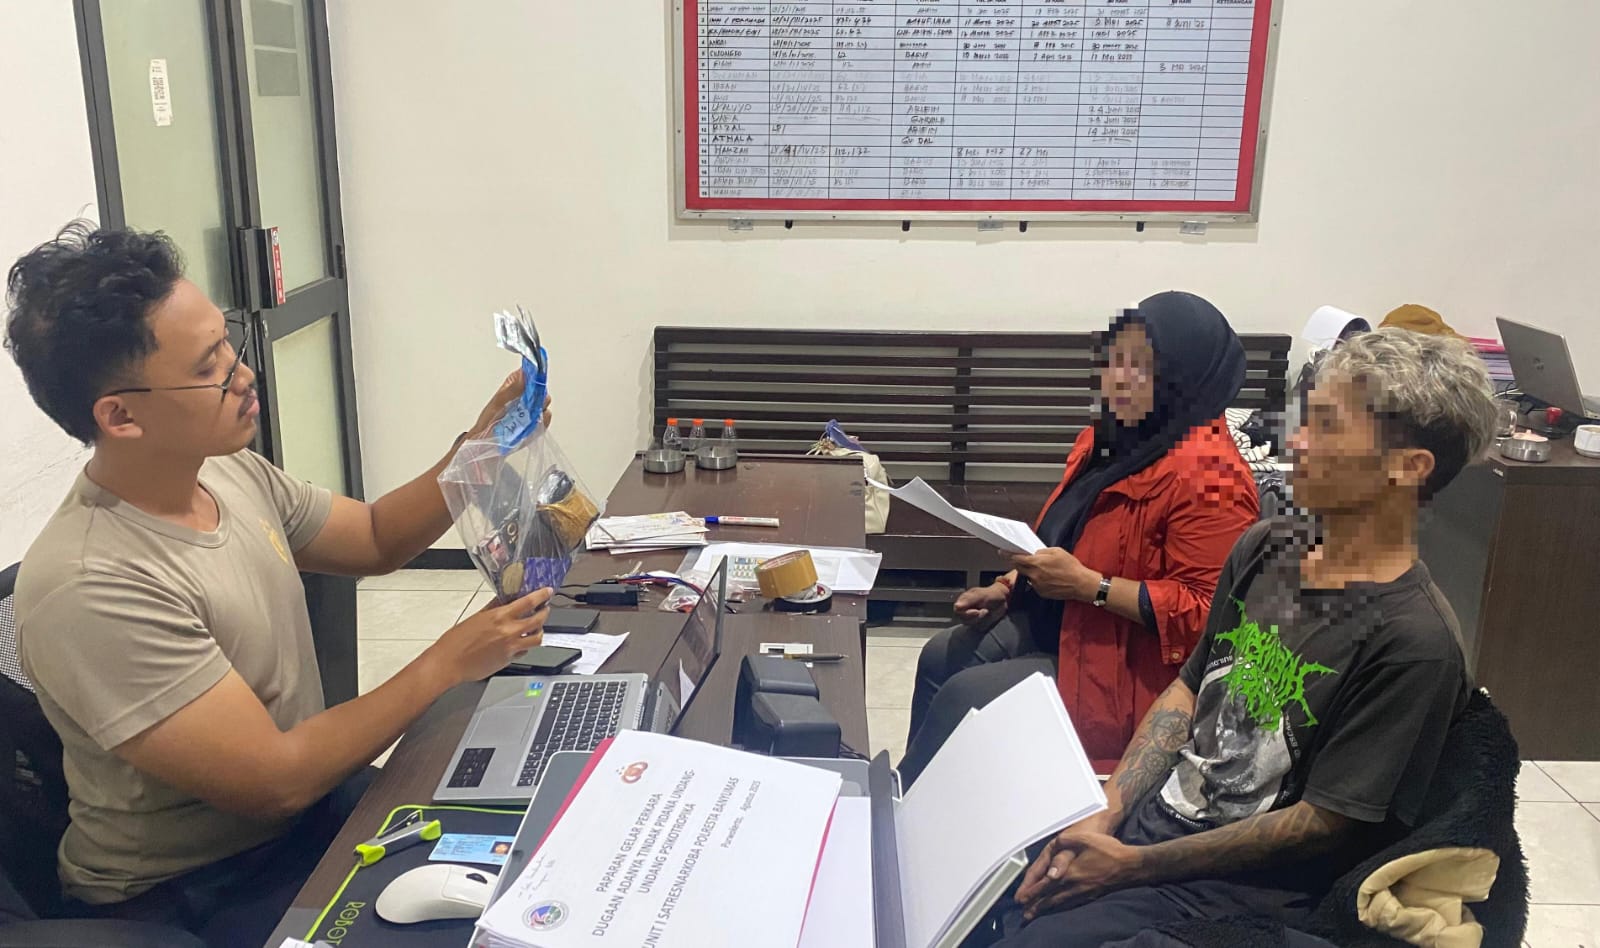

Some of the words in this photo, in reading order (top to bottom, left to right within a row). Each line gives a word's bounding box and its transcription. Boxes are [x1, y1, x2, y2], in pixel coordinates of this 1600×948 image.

[592, 896, 624, 936] DUGAAN
[617, 855, 645, 894] ADANYA
[636, 828, 662, 860] TINDAK
[654, 801, 678, 827] PIDANA
[596, 853, 627, 892] PAPARAN
[620, 827, 642, 852] GELAR
[635, 793, 663, 826] PERKARA
[637, 856, 667, 893] UNDANG
[659, 804, 696, 855] PSIKOTROPIKA
[658, 849, 702, 919] SATRESNARKOBA
[694, 814, 720, 847] POLRESTA
[712, 777, 739, 812] BANYUMAS
